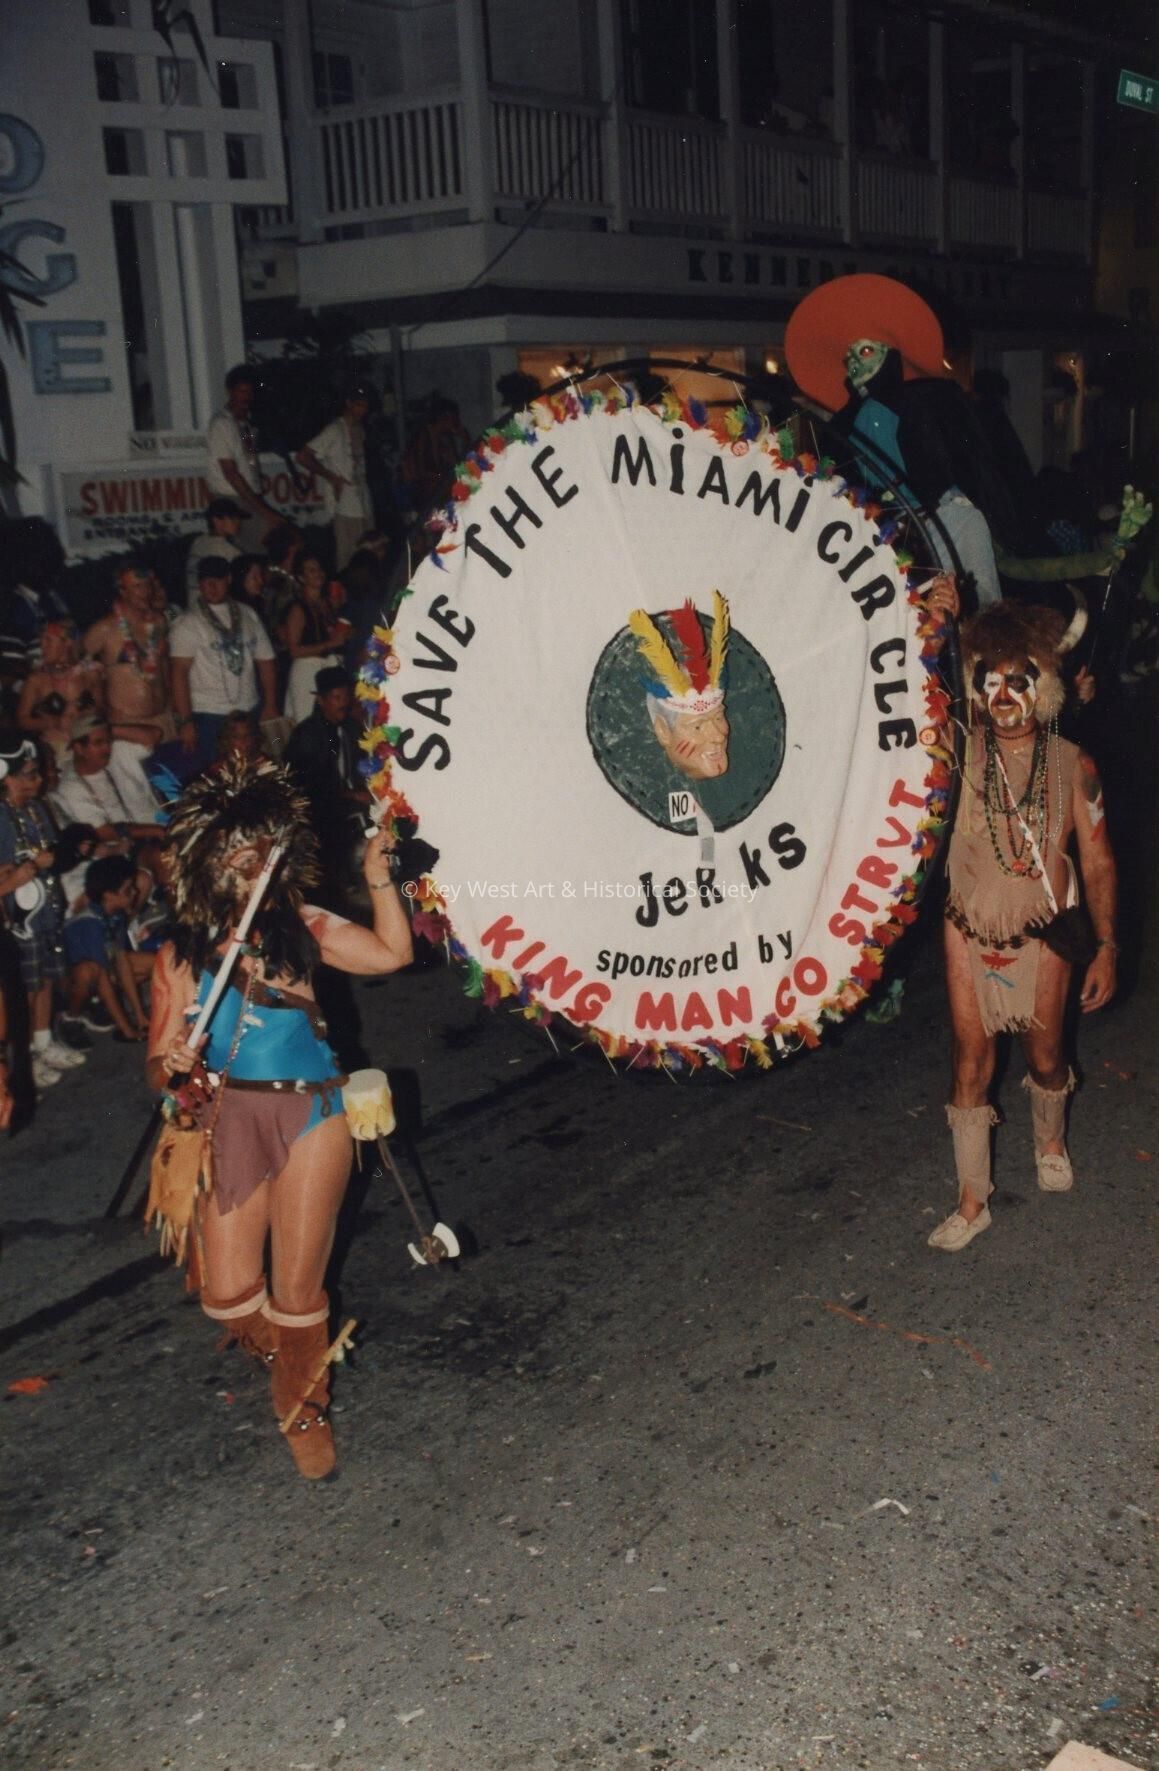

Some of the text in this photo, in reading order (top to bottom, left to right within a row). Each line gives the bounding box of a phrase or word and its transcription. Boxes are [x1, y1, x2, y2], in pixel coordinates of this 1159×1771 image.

[81, 477, 210, 514] SWIMMIN
[398, 595, 475, 772] SAVE
[464, 446, 579, 578] THE
[671, 794, 688, 817] NO
[481, 915, 612, 1022] KING
[596, 930, 792, 979] sponsored by
